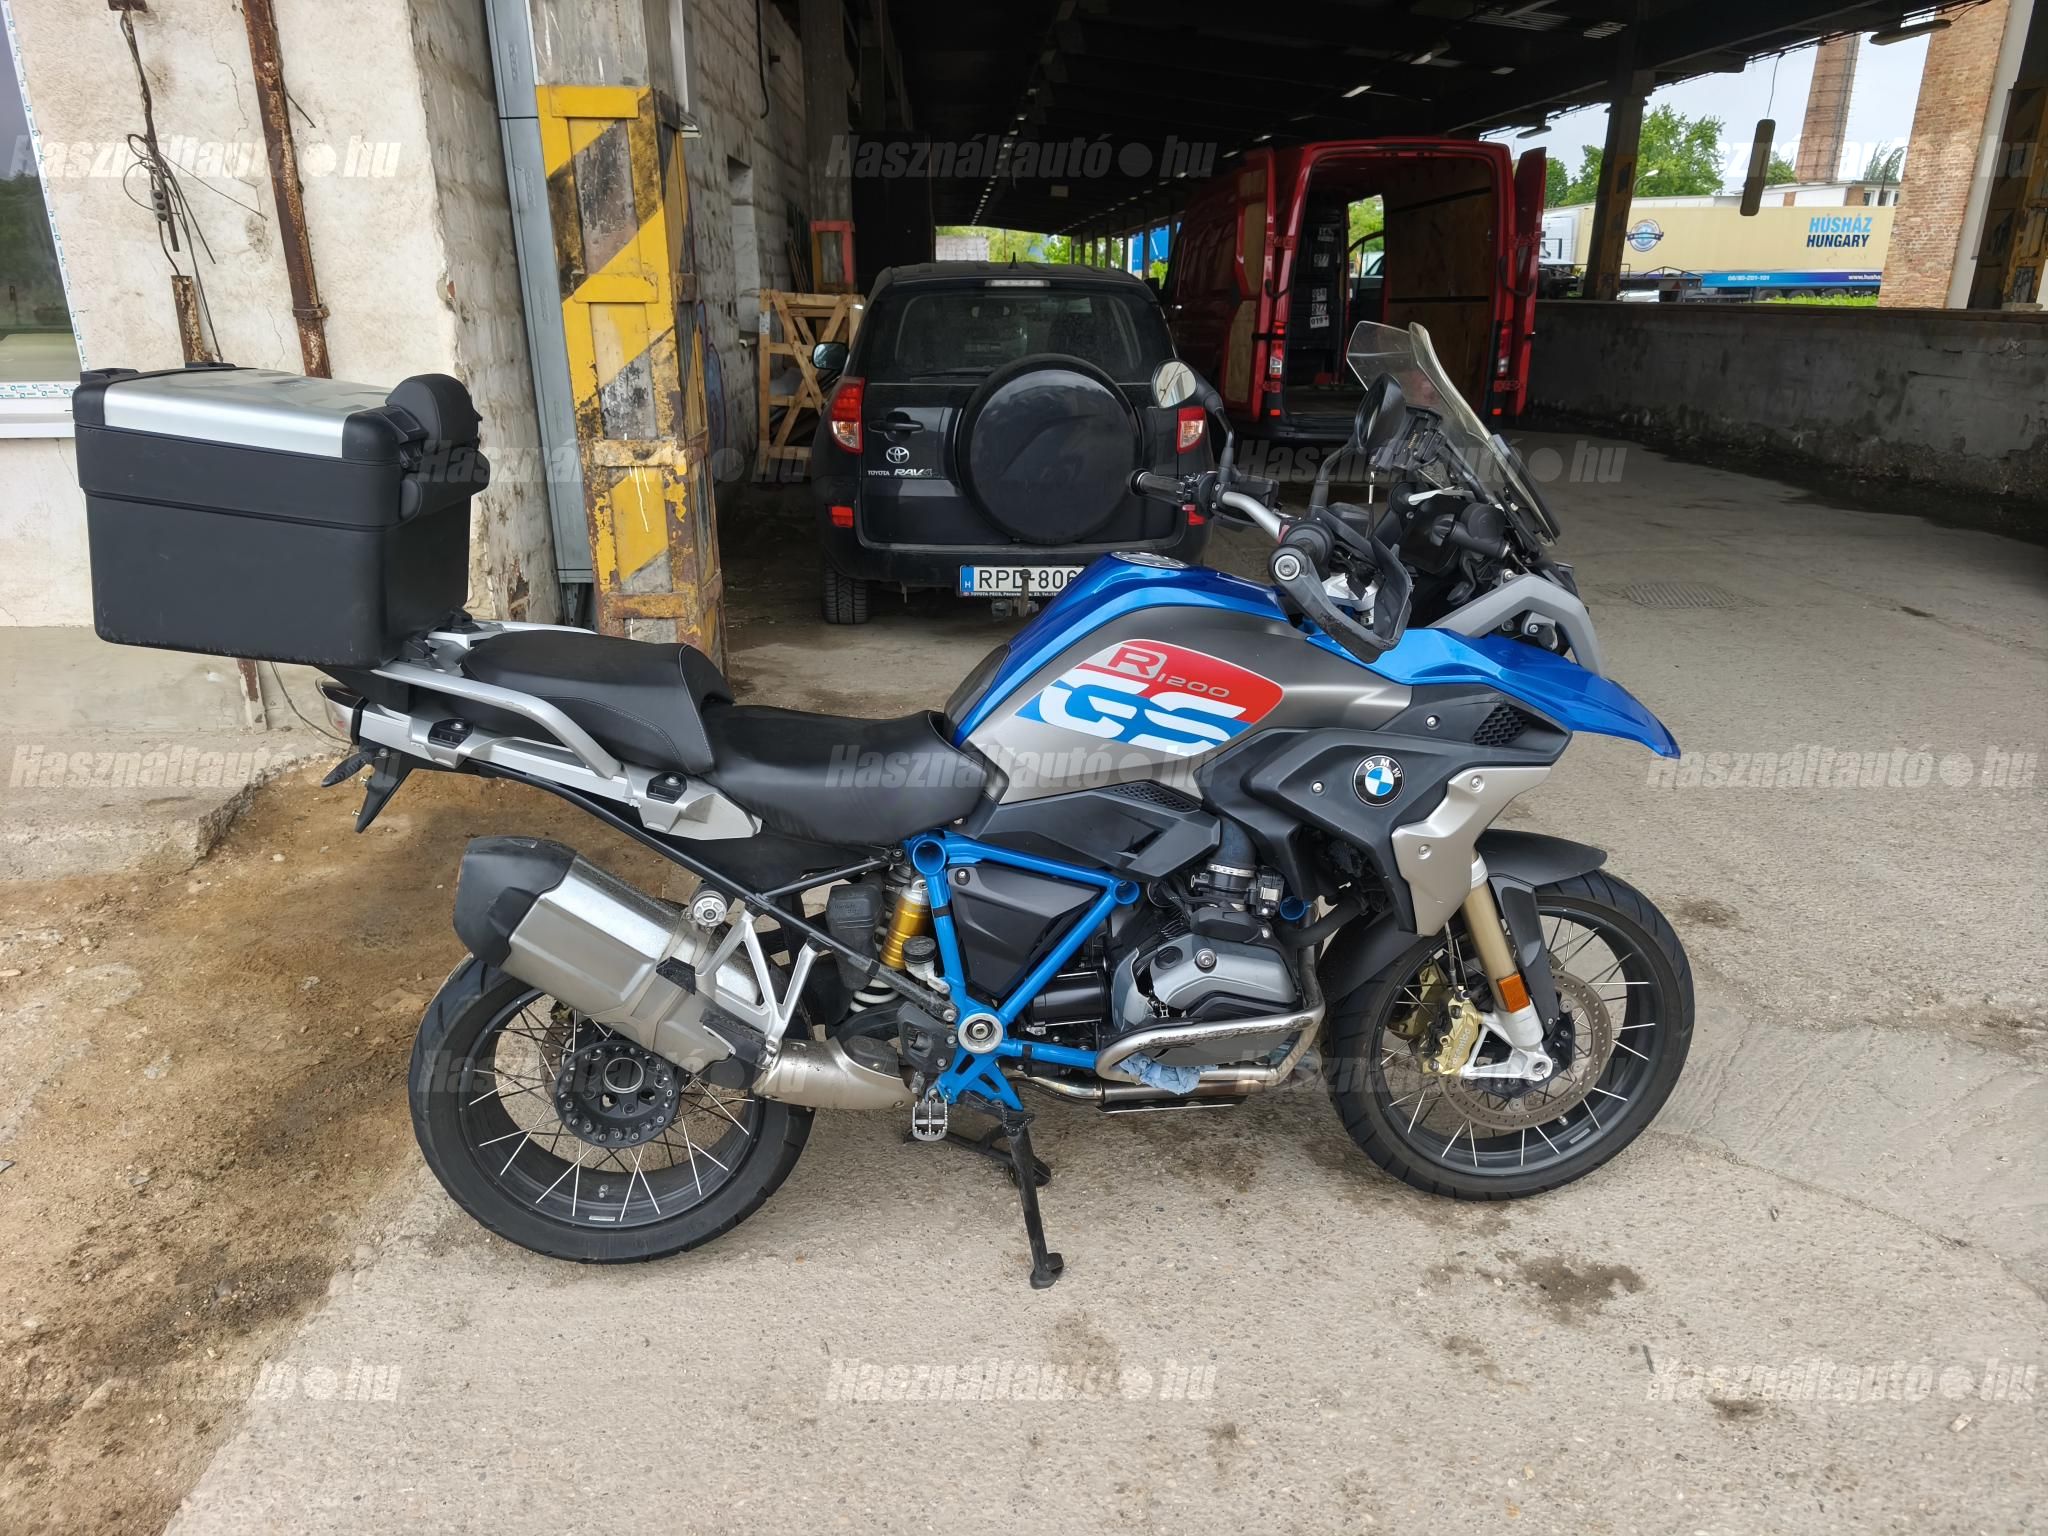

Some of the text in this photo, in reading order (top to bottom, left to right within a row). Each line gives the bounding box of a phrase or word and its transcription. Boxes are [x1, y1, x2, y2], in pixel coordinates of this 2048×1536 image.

[1808, 213, 1873, 233] HÚSHÁZ
[1806, 234, 1870, 248] HUNGARY
[1156, 673, 1231, 699] 1200
[1038, 668, 1247, 757] GS
[1364, 758, 1402, 778] BMW
